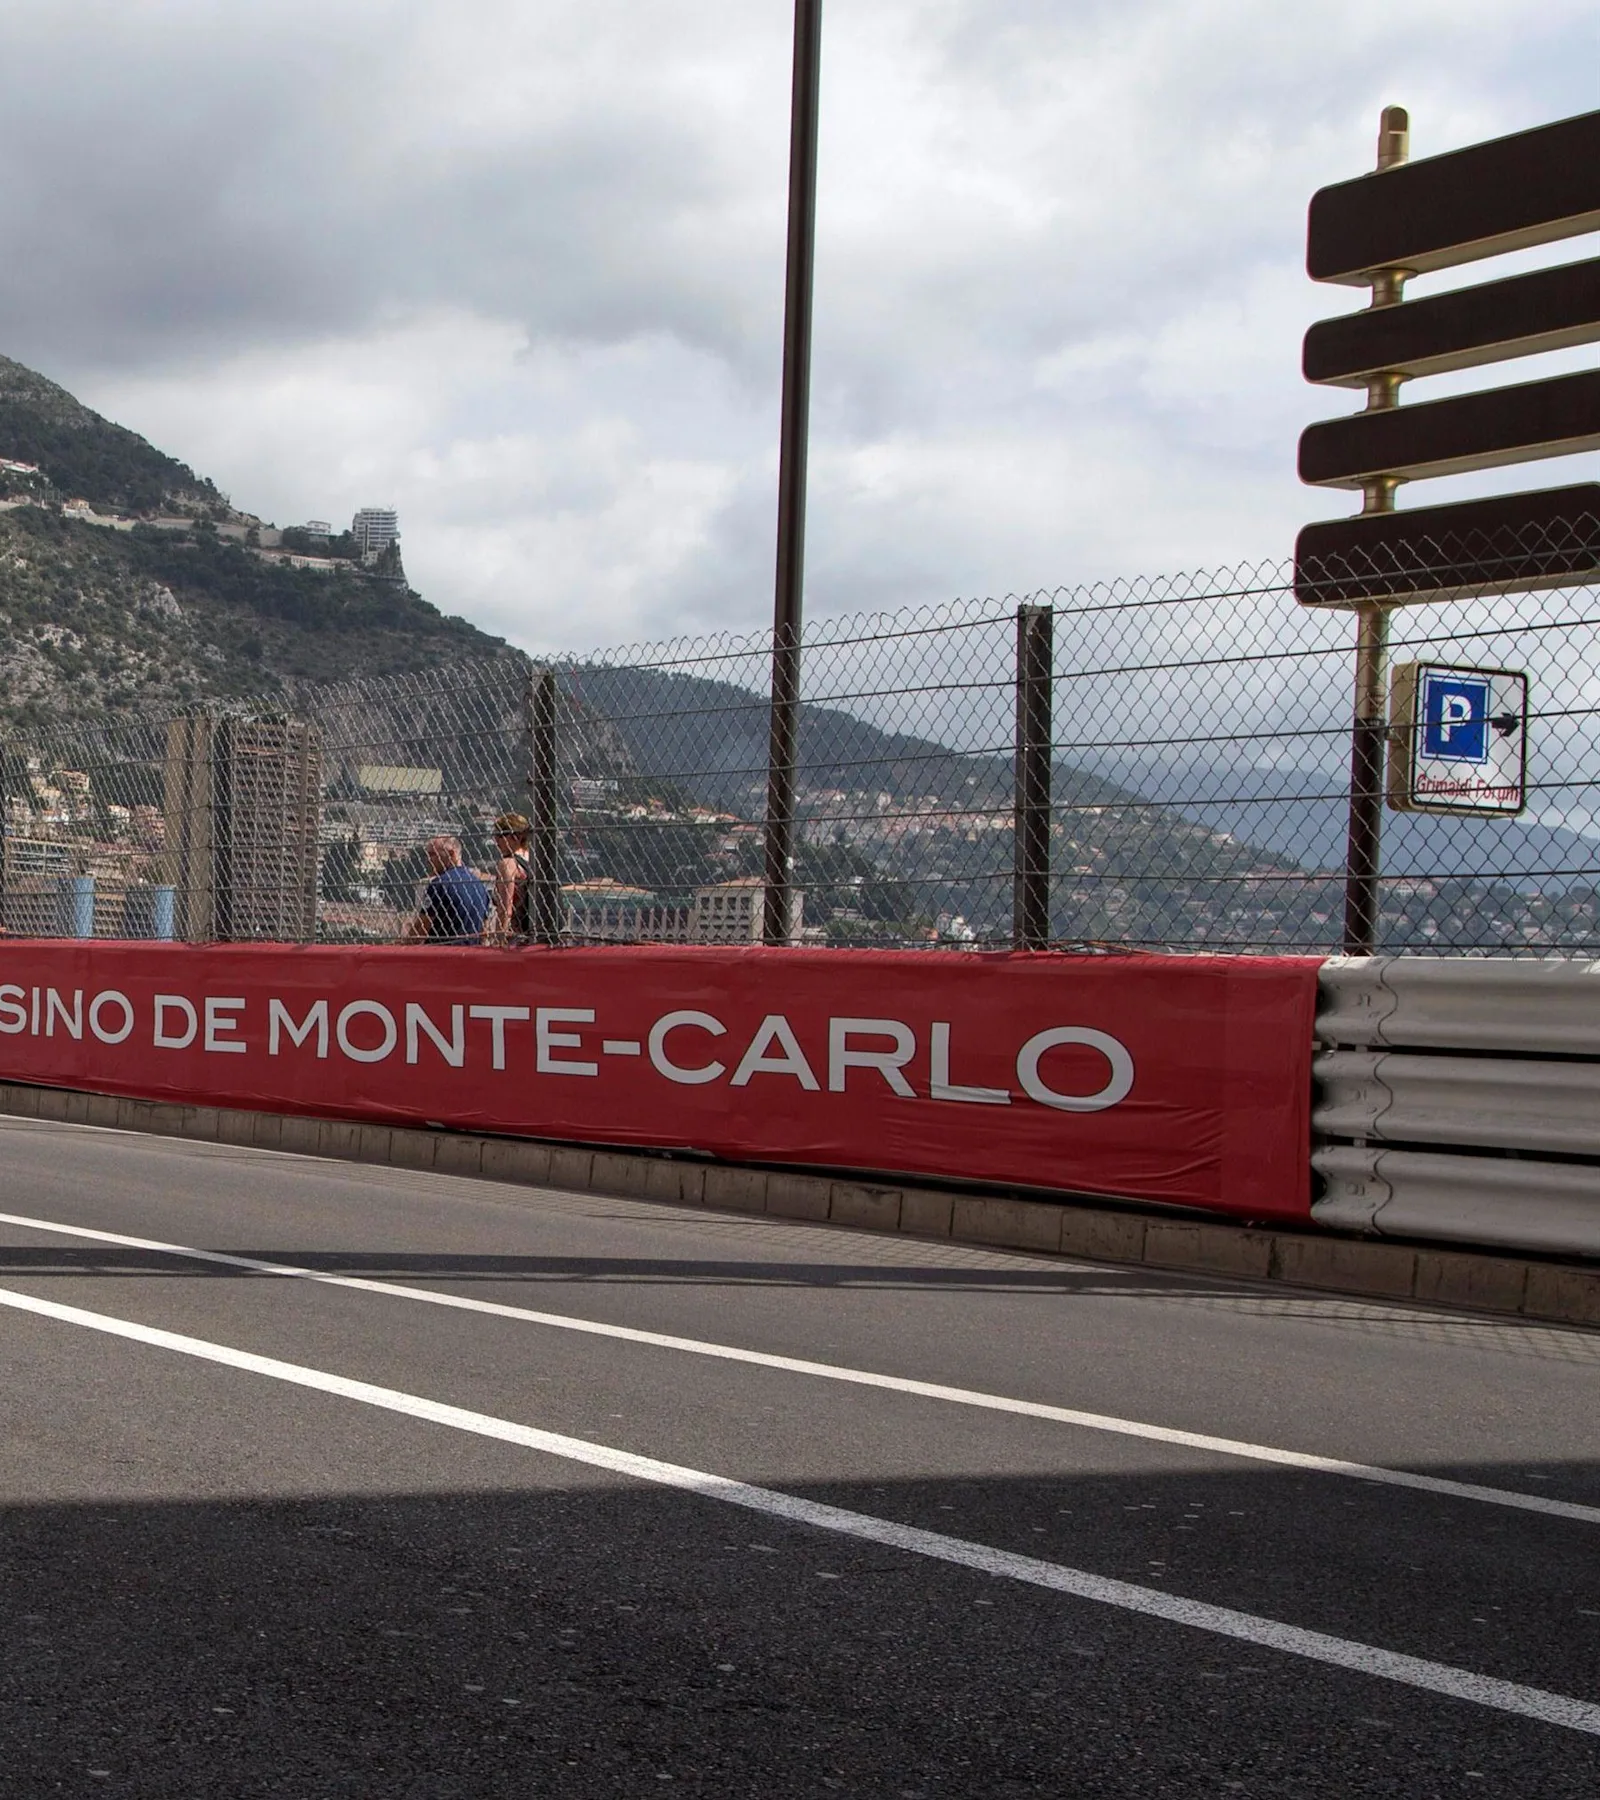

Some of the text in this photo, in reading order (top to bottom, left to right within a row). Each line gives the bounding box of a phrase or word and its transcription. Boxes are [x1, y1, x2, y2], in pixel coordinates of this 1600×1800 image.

[1440, 694, 1472, 742] P
[1416, 774, 1518, 802] Grimaldi Forum
[153, 994, 247, 1054] DE
[268, 997, 1135, 1112] MONTE-CARLO
